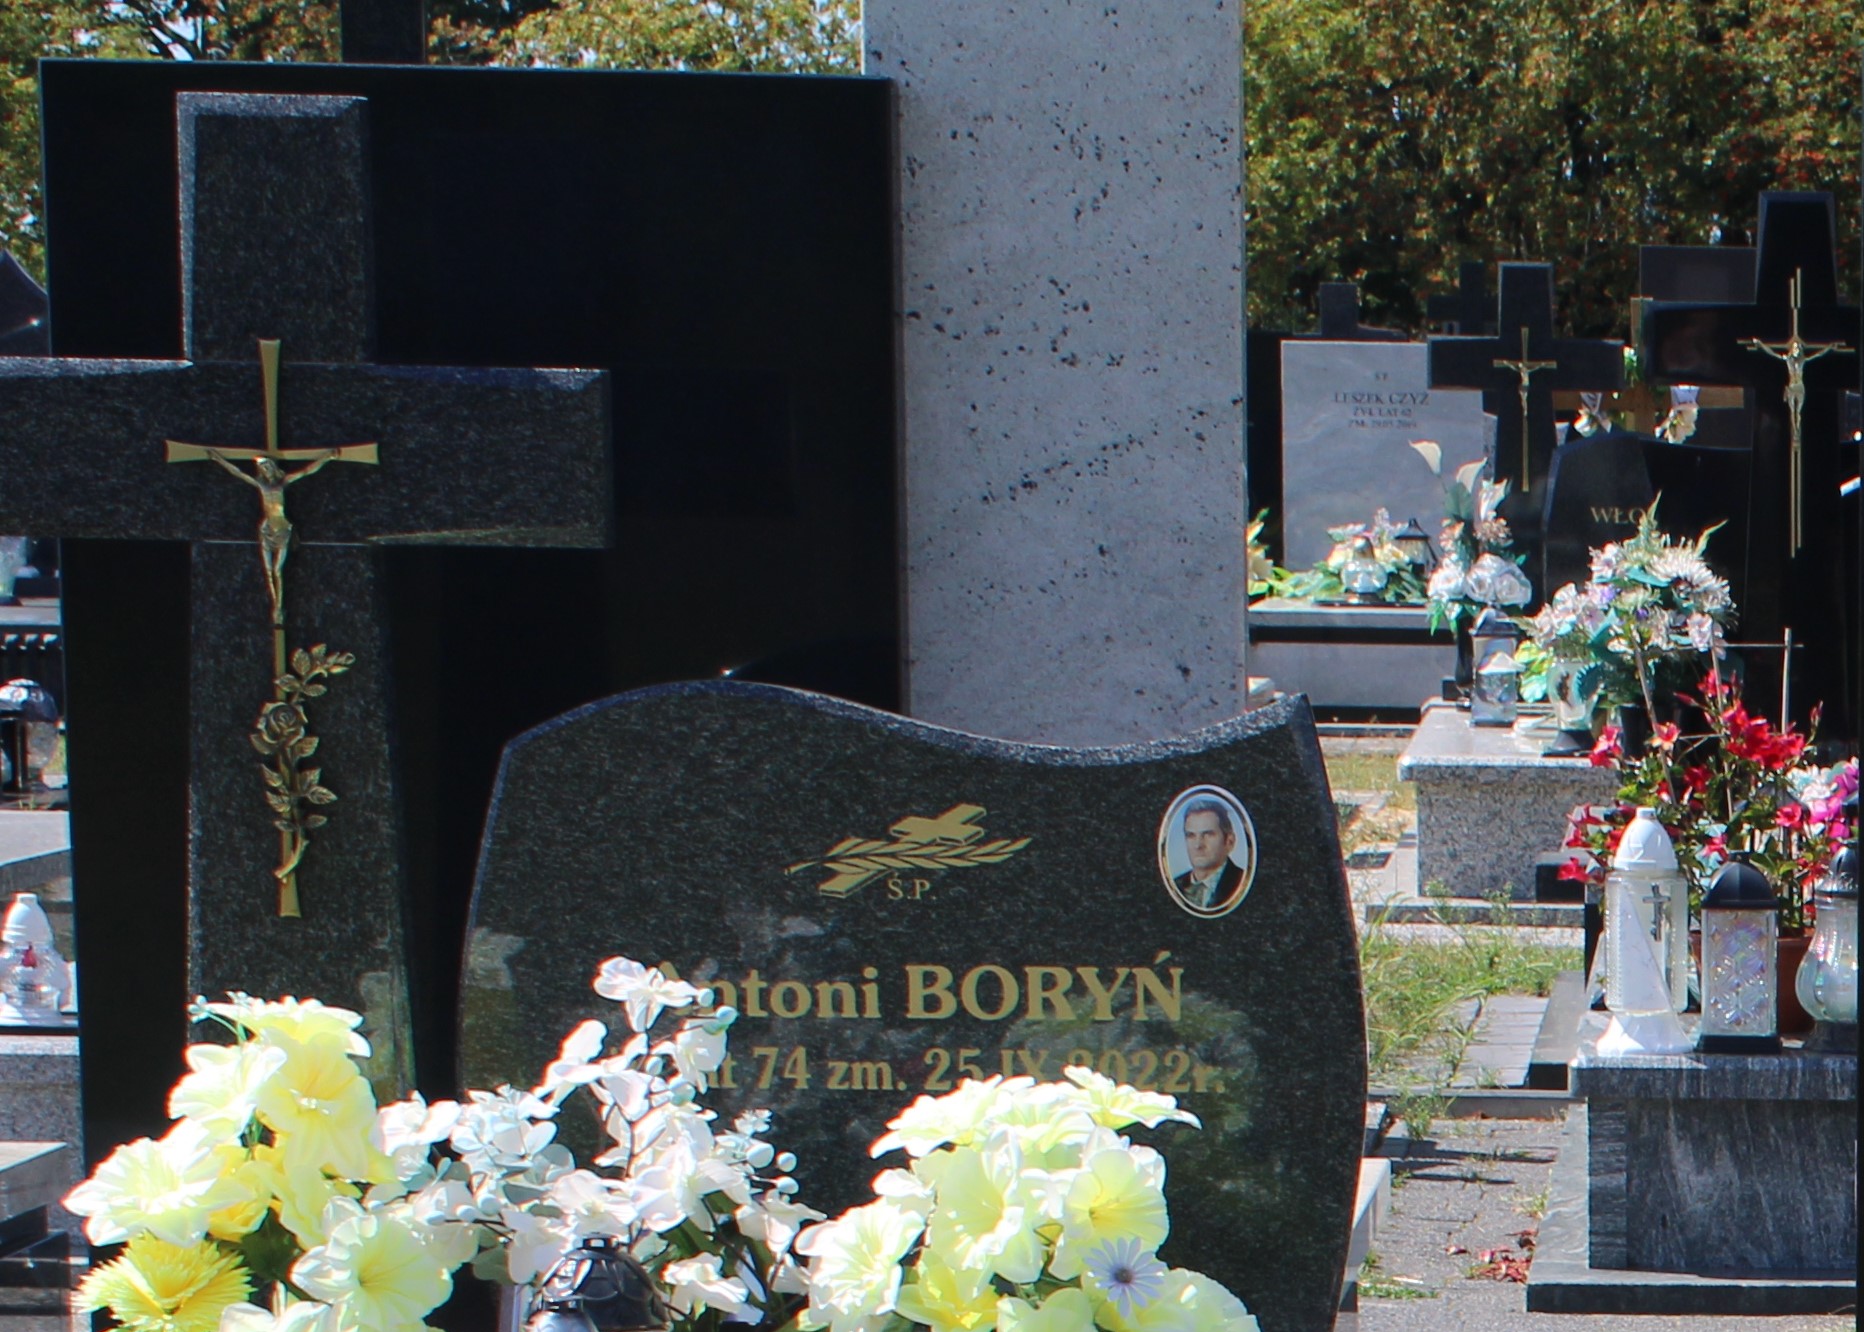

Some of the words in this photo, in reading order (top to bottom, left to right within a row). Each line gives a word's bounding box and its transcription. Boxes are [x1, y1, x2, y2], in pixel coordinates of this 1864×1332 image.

[904, 951, 1184, 1021] BORYŃ
[753, 1046, 811, 1090] 74
[826, 1060, 907, 1091] zm.
